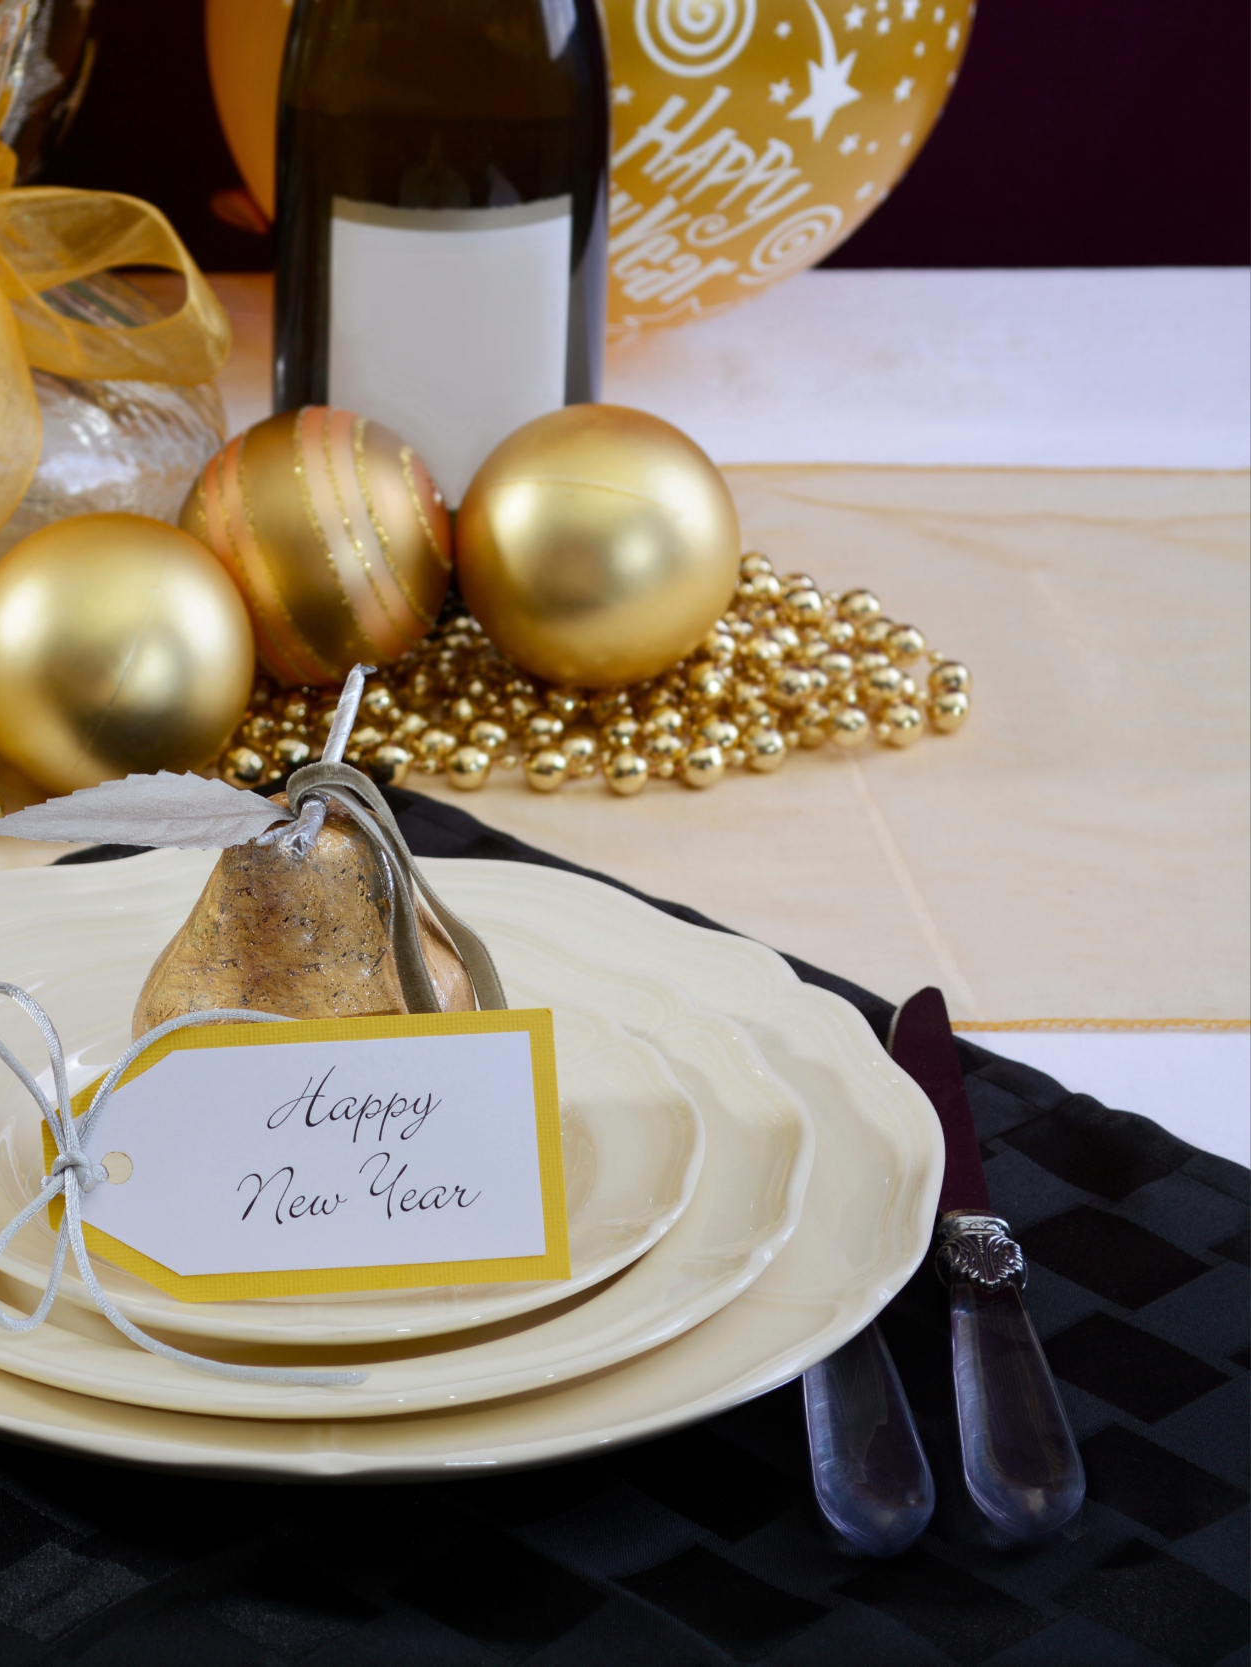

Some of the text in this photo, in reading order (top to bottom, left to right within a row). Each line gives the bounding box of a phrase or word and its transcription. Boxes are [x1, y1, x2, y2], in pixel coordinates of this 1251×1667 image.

[266, 1065, 442, 1143] Happy
[236, 1151, 482, 1225] New Year
